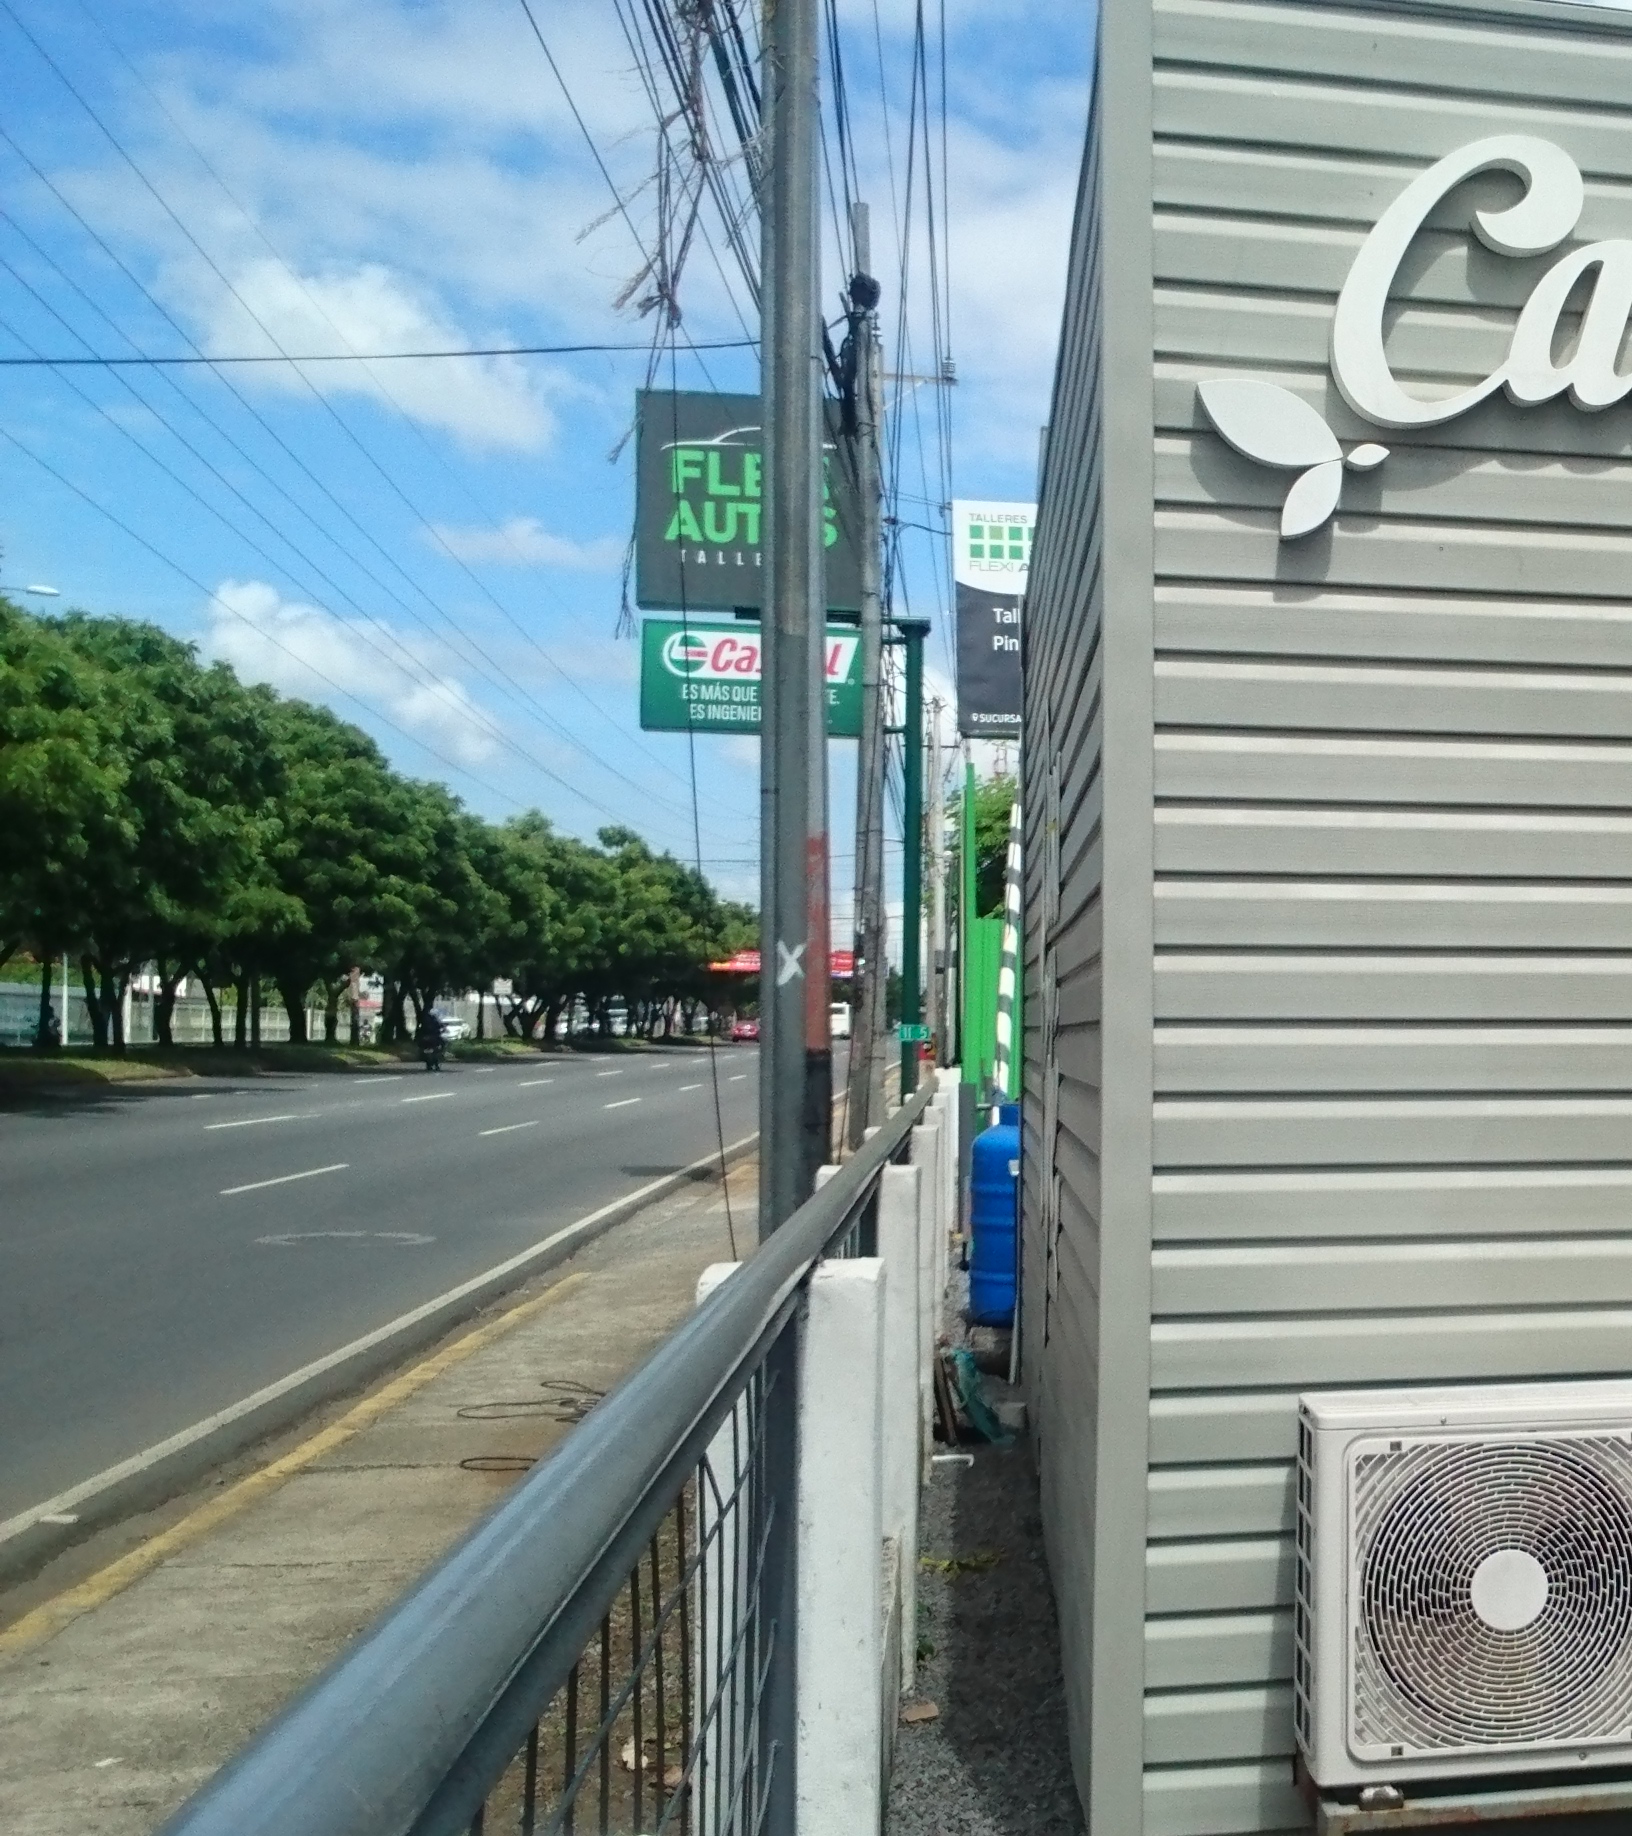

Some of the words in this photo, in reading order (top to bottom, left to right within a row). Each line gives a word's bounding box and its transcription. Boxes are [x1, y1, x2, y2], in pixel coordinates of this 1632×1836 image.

[672, 449, 830, 497] FLE
[664, 499, 838, 547] AUTS
[969, 513, 1028, 524] TALLERES
[992, 607, 1021, 624] Tall
[992, 634, 1019, 651] Pin
[702, 681, 730, 701] MÁS
[732, 685, 758, 702] QUE
[690, 703, 706, 720] ES
[979, 713, 1022, 723] SUCURSA
